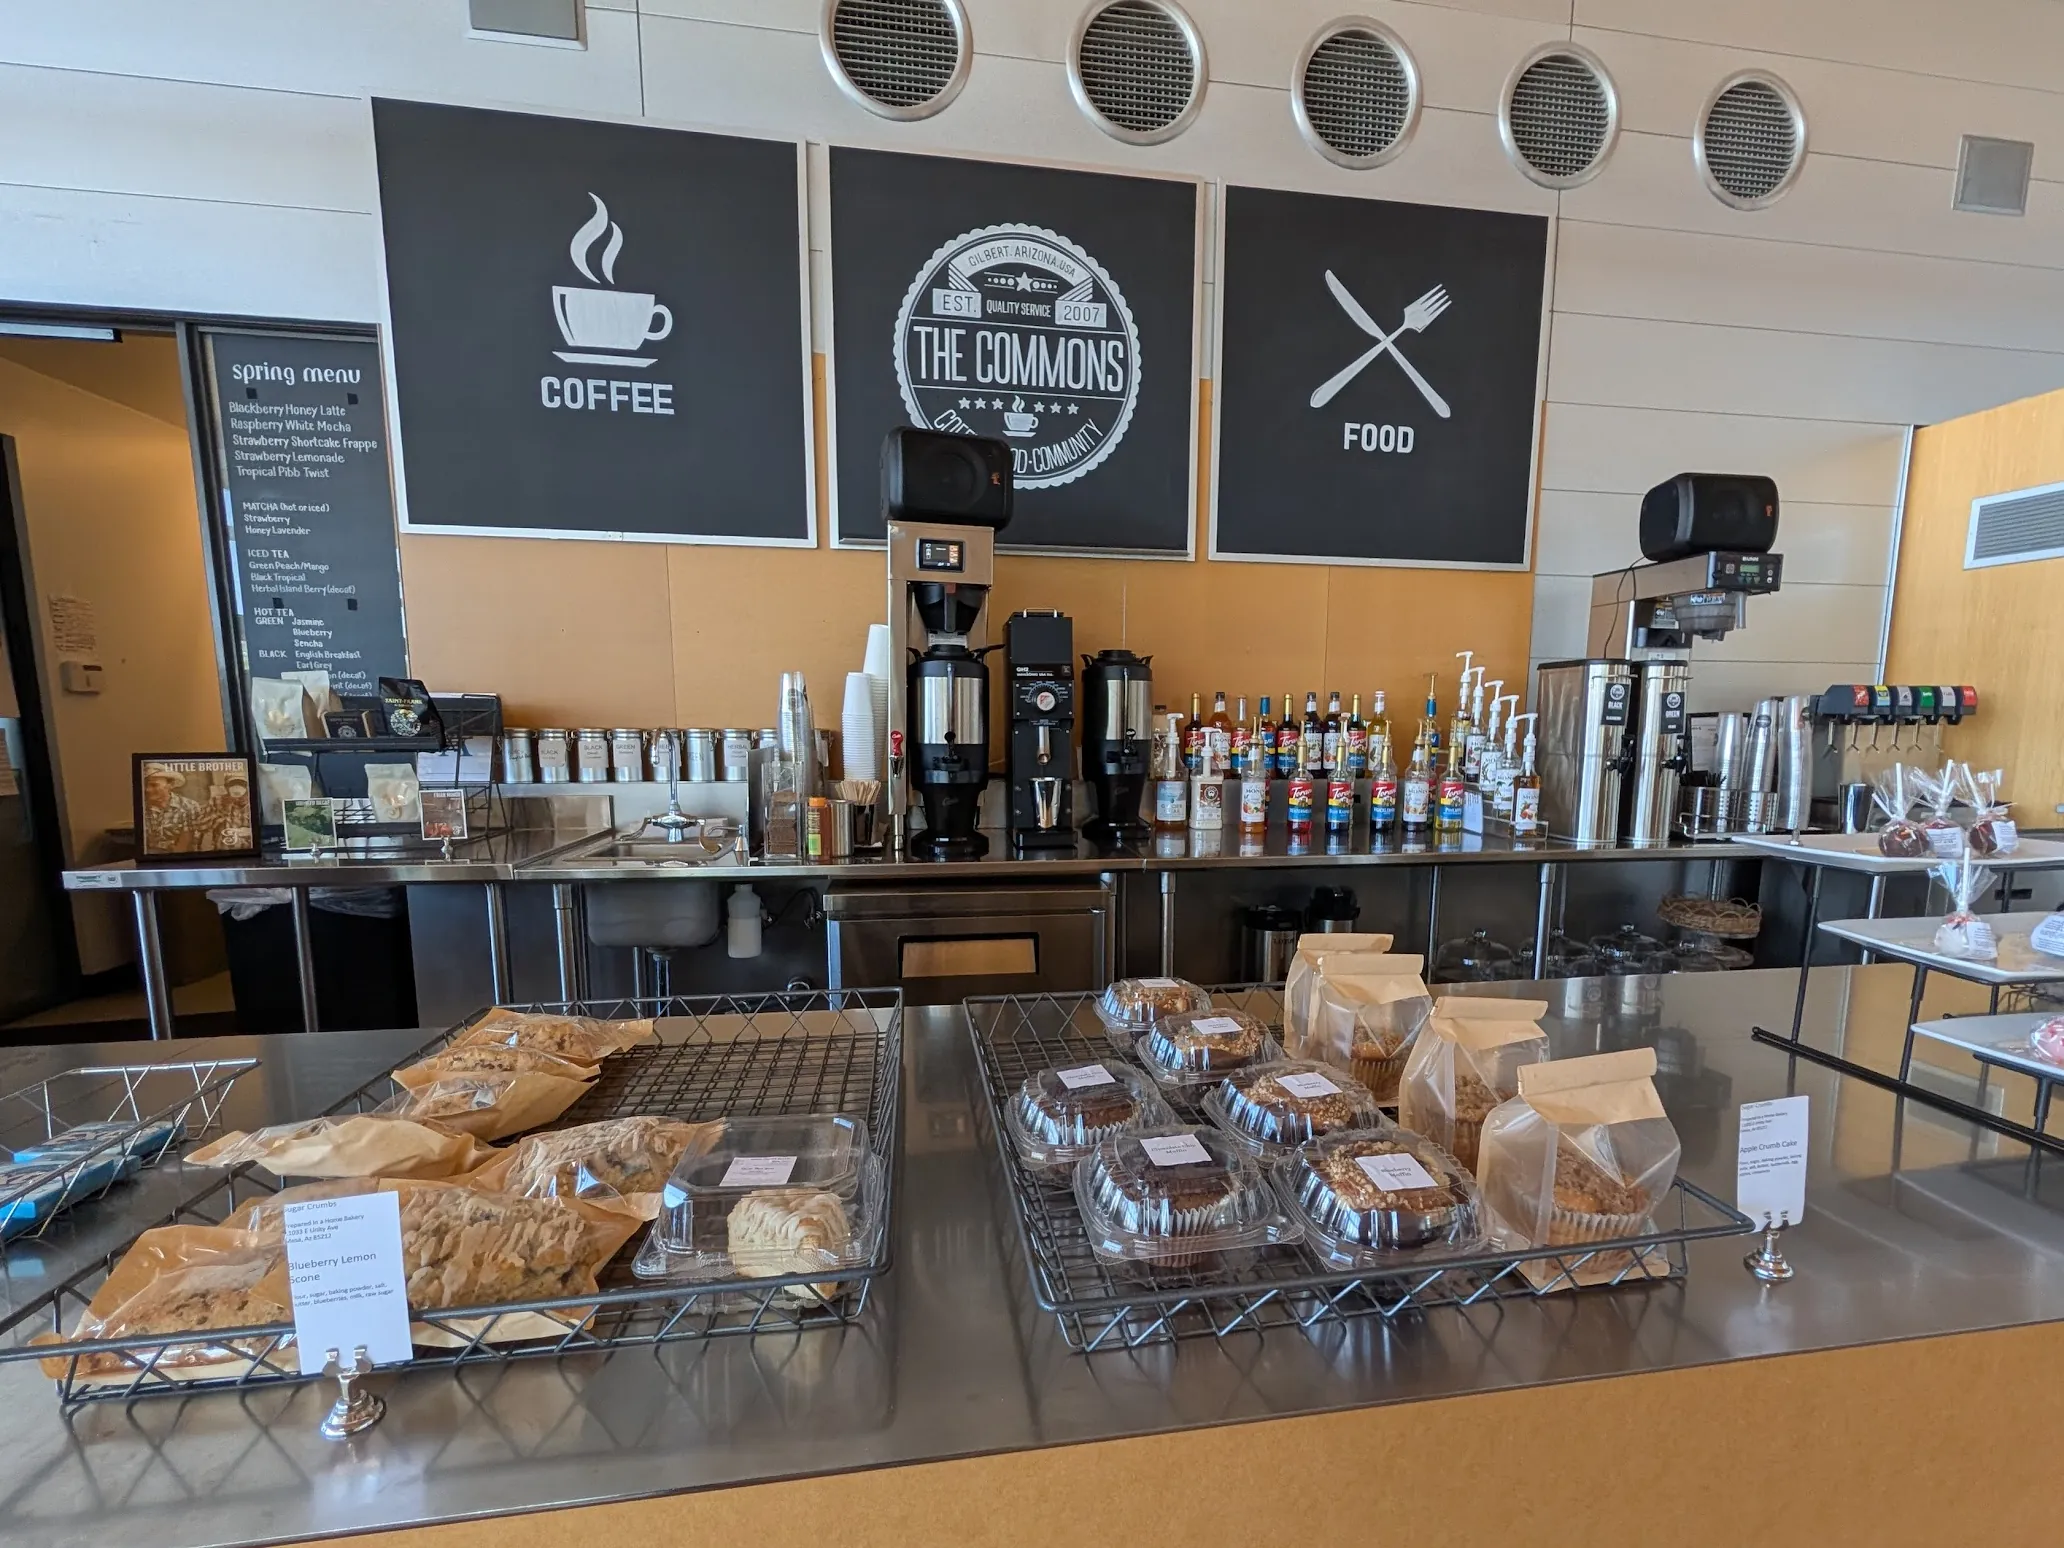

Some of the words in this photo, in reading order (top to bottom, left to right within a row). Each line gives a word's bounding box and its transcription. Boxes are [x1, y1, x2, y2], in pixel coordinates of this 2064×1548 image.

[1059, 260, 1077, 278] USA
[942, 293, 977, 313] EST.
[986, 299, 1020, 315] QUALITY
[1020, 301, 1051, 318] SERVICE
[1063, 305, 1100, 323] 2007
[913, 326, 967, 382] THE
[976, 330, 1124, 392] COMMONS
[232, 361, 295, 385] spring
[303, 367, 361, 384] menu
[540, 376, 675, 415] COFFEE
[229, 401, 284, 417] Blackberry
[285, 403, 319, 418] Honey
[320, 405, 346, 416] Latte
[231, 418, 284, 433] Raspberry
[284, 419, 315, 431] White
[317, 421, 352, 432] Mocha
[233, 434, 290, 449] Strawberry
[291, 435, 341, 448] Shortcake
[343, 438, 378, 452] Frappe
[1343, 422, 1415, 454] FOOD
[234, 450, 291, 464] Strawberry
[292, 451, 345, 463] Lemonade
[237, 465, 277, 480] Tropical
[278, 466, 301, 477] Pibb
[303, 467, 330, 478] Twist
[243, 502, 279, 512] MATCHA
[243, 514, 291, 525] Strawberry
[245, 525, 271, 537] Honey
[272, 526, 312, 536] Lavender
[248, 549, 269, 558] ICED
[271, 550, 290, 559] TEA
[249, 562, 275, 570] Green
[251, 572, 273, 582] Black
[274, 573, 306, 583] Tropical
[251, 584, 278, 593] Herbal
[279, 584, 303, 593] Island
[304, 585, 328, 596] Berry
[254, 607, 273, 616] HOT
[276, 608, 295, 617] TEA
[255, 617, 285, 625] GREEN
[291, 618, 324, 626] Jasmine
[293, 628, 333, 639] Blueberry
[294, 639, 324, 648] Sencha
[259, 650, 287, 658] BLACK
[295, 650, 324, 660] English
[325, 651, 361, 659] Breakfast
[296, 661, 313, 669] Earl
[313, 661, 333, 671] Grey
[164, 762, 196, 772] LITTLE
[199, 762, 244, 772] BROTHER
[1759, 1142, 1780, 1150] Crumb
[307, 1201, 337, 1210] Crumbs
[341, 1252, 377, 1264] Lemon
